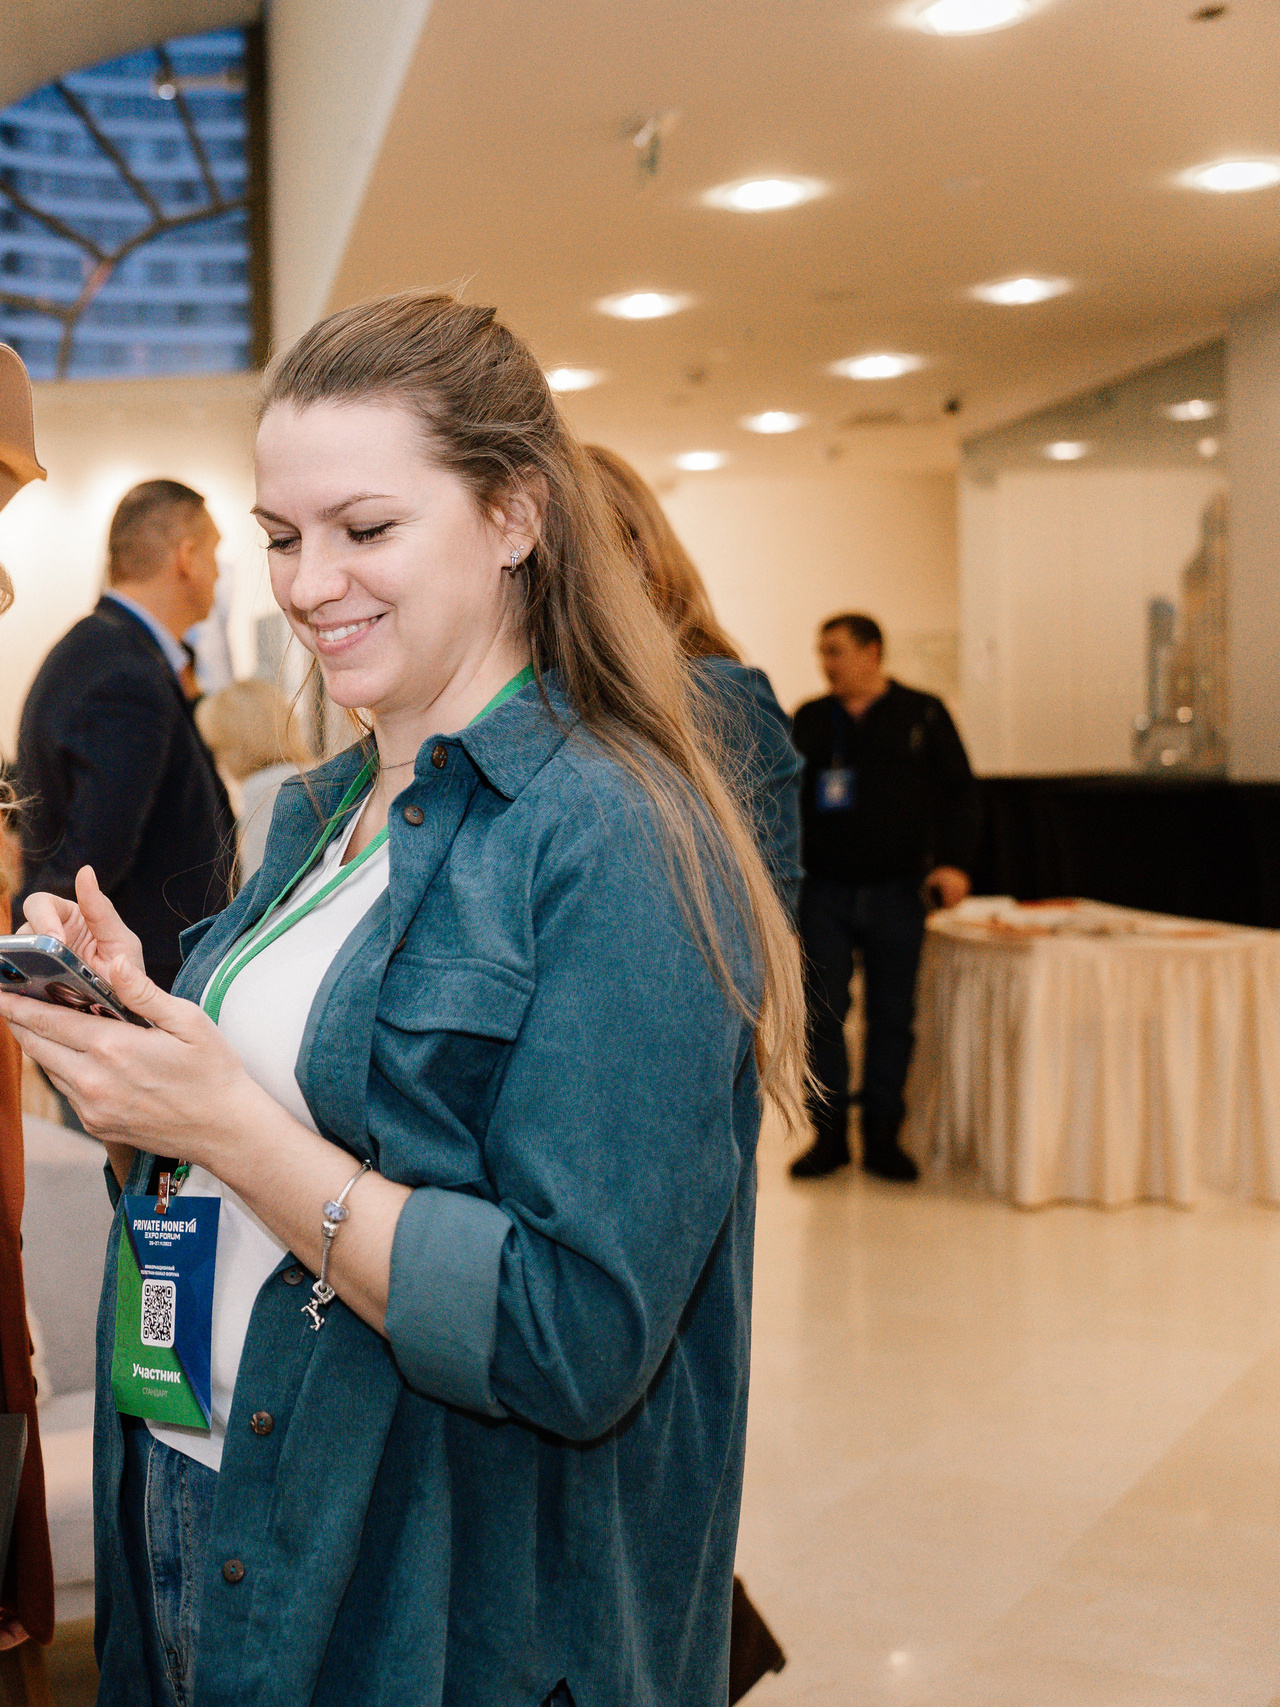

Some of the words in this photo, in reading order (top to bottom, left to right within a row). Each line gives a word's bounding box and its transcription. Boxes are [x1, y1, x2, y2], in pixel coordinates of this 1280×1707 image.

[133, 1219, 160, 1231] PRIVATE
[161, 1218, 197, 1233] MONEY
[159, 1232, 181, 1240] FORUM
[132, 1362, 181, 1384] Участник
